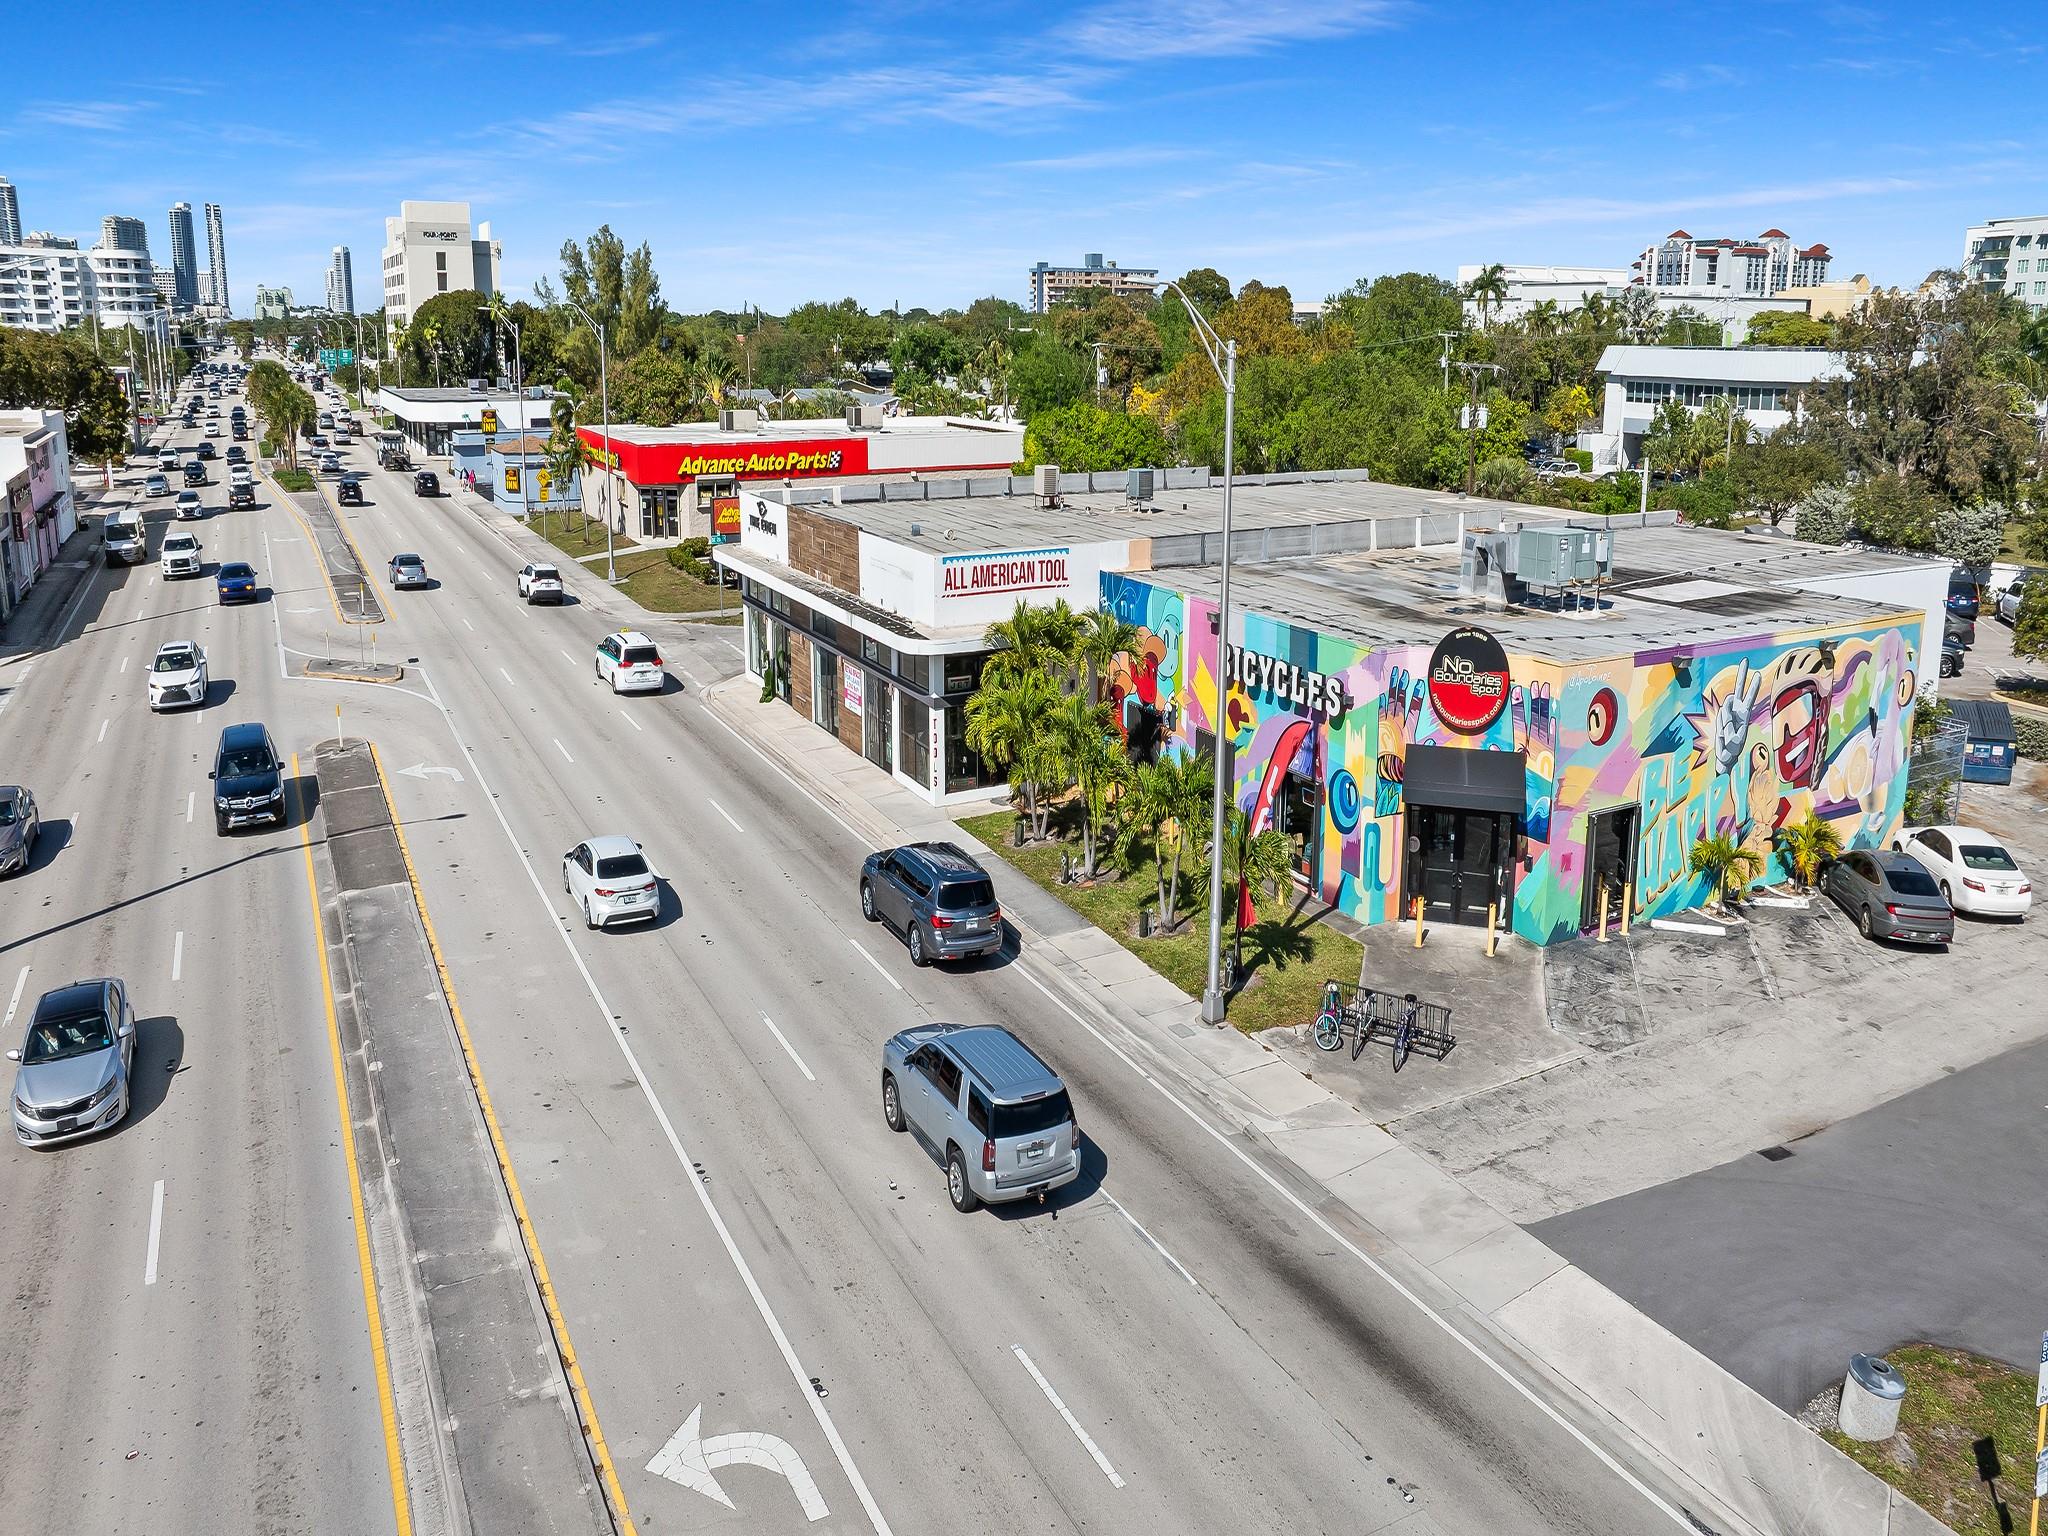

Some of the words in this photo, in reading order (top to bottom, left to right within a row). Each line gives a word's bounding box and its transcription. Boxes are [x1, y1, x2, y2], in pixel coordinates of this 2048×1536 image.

[483, 423, 497, 433] INN
[678, 456, 744, 475] Advance
[745, 453, 785, 472] Auto
[506, 482, 518, 491] INN
[944, 566, 968, 592] ALL
[971, 561, 1035, 588] AMERICAN
[1038, 559, 1069, 582] TOOL
[1442, 655, 1474, 675] No
[1434, 669, 1502, 687] Boundaries
[1471, 684, 1502, 697] Sport
[1431, 692, 1503, 727] noboundariessport.com
[1638, 746, 1693, 838] BE
